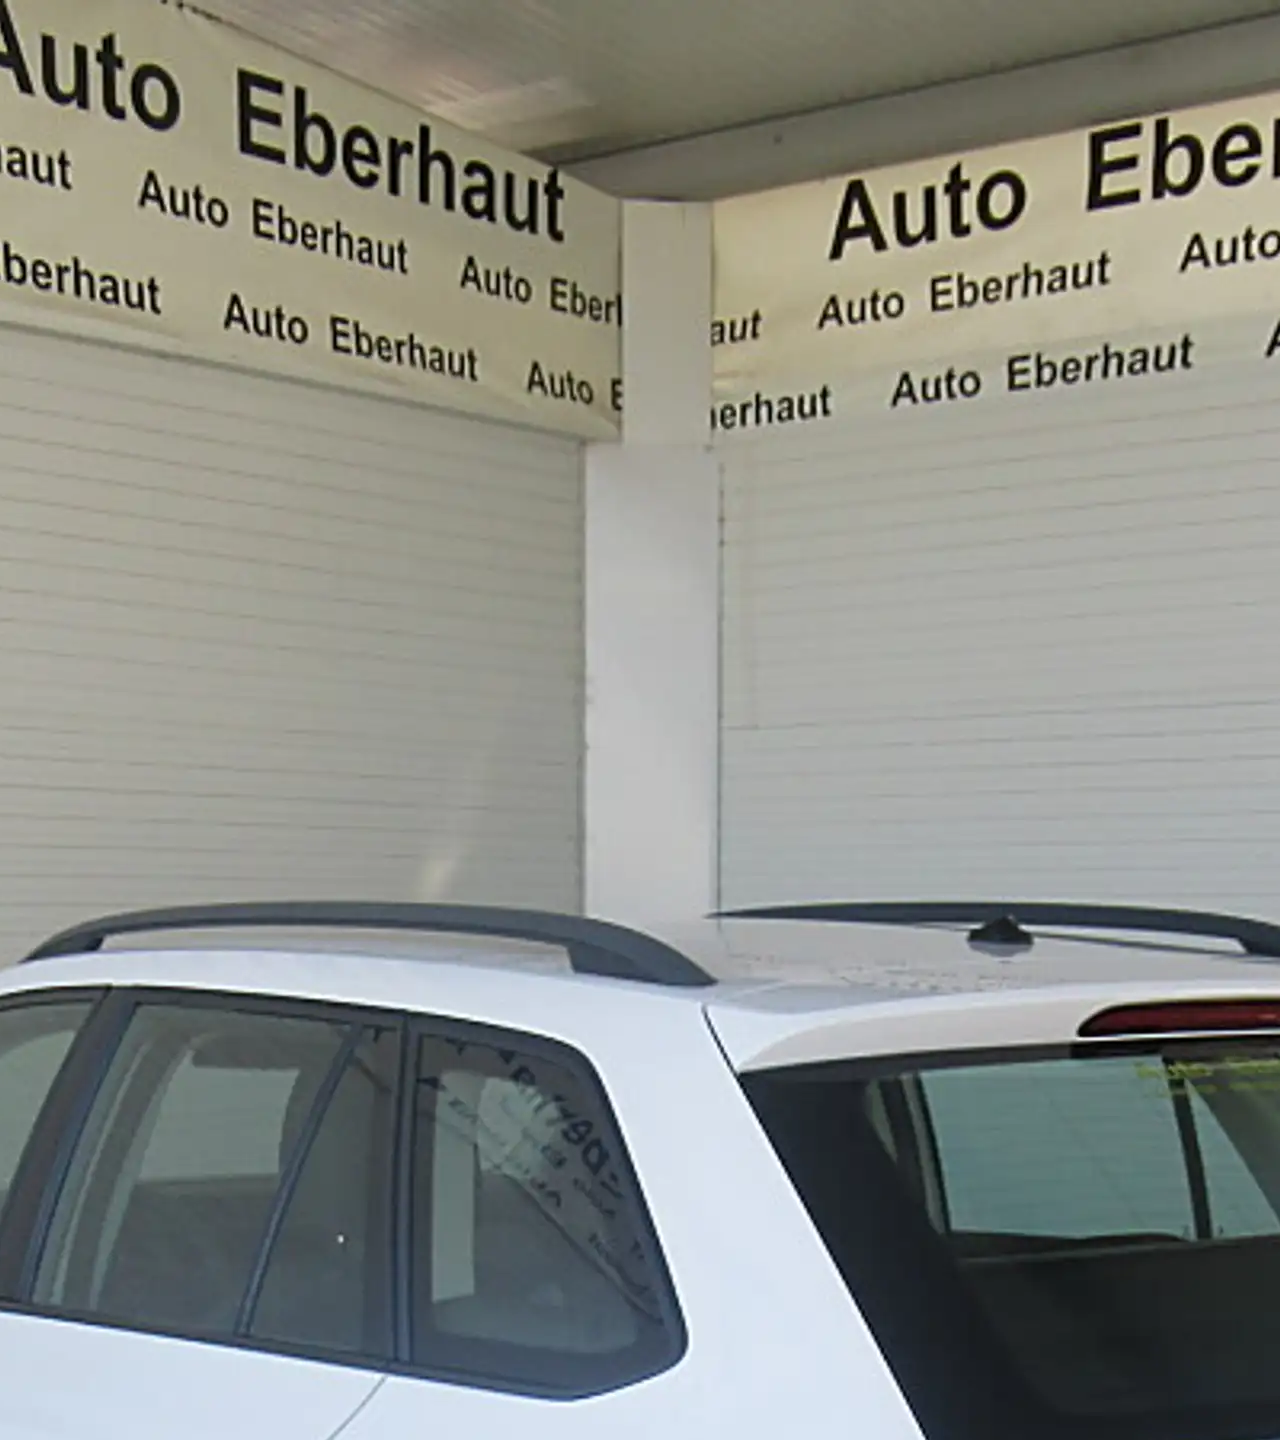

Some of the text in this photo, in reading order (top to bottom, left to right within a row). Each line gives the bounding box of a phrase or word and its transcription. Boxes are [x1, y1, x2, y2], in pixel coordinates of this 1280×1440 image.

[236, 67, 565, 243] Eberhaut
[138, 169, 408, 276] Auto Eberhaut
[828, 161, 1028, 261] Auto
[459, 255, 534, 304] Auto
[817, 251, 1111, 330] Auto Eberhaut
[223, 293, 479, 382] Auto Eberhaut
[891, 334, 1195, 408] Auto Eberhaut
[526, 360, 596, 406] Auto
